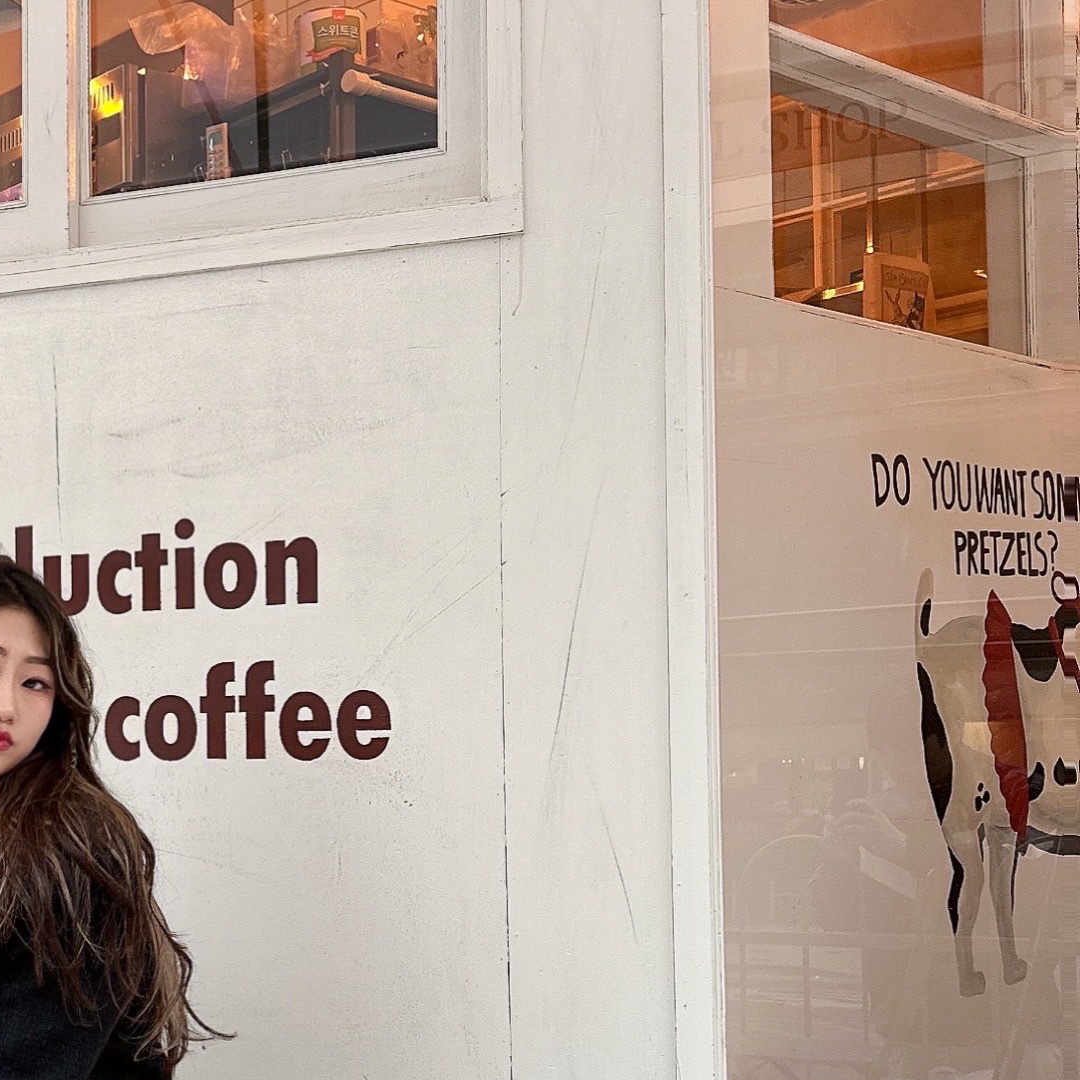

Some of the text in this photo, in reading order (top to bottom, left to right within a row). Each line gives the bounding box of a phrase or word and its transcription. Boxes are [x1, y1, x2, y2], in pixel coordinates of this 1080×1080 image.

[317, 24, 359, 39] 스위트콘
[871, 453, 911, 507] DO
[922, 457, 972, 512] YOU
[974, 464, 1027, 518] WANT
[954, 530, 1059, 577] PRETZELS?
[104, 659, 392, 762] coffee
